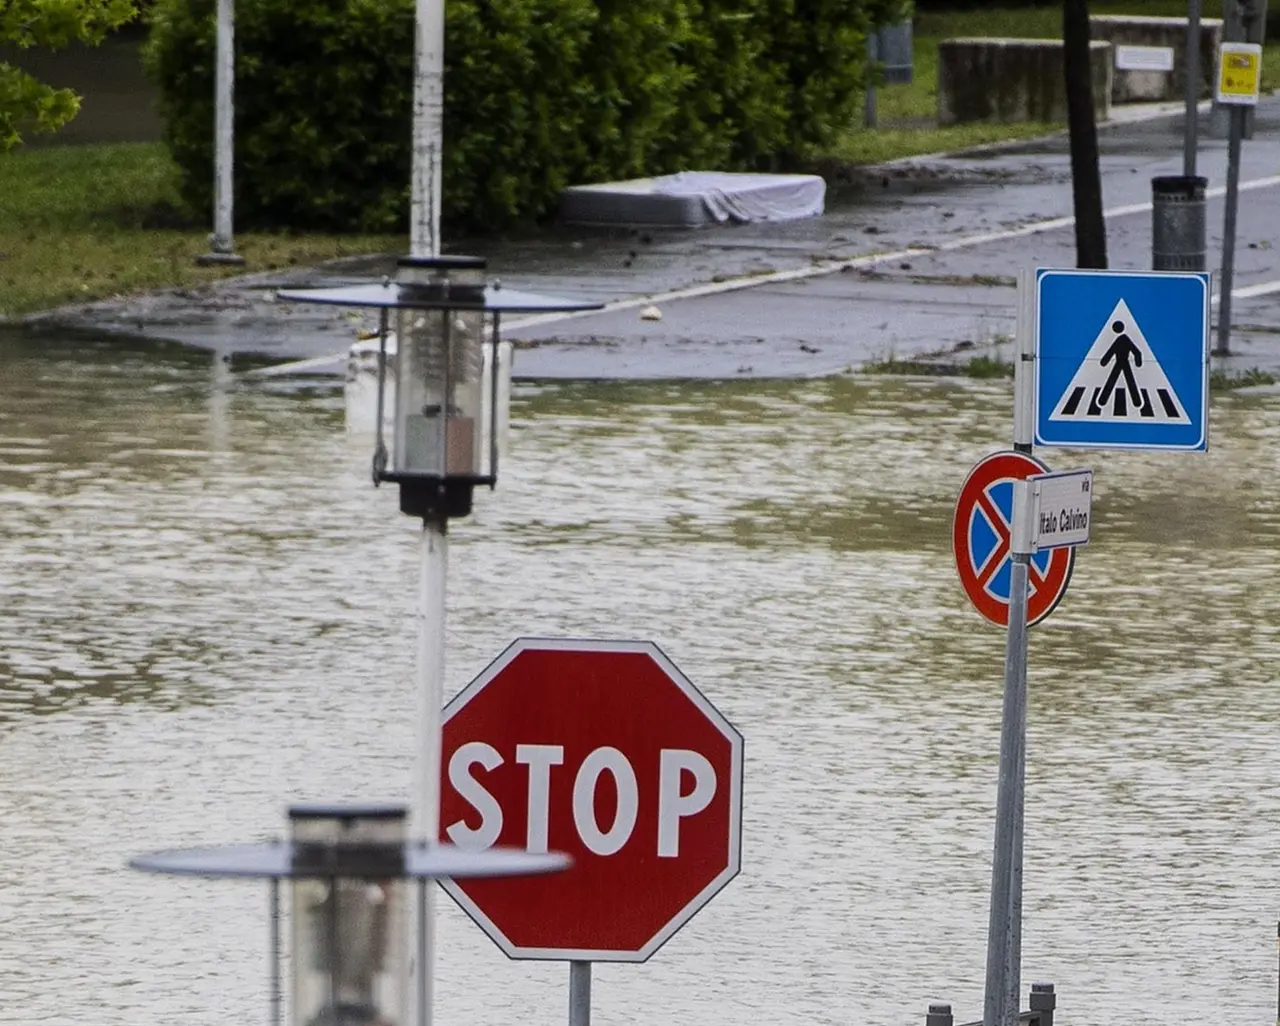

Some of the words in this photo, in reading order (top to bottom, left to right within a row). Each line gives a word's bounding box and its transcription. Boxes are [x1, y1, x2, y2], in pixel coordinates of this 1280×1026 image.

[1040, 511, 1057, 534] Italo
[1060, 508, 1087, 532] Calvino
[446, 742, 717, 858] STOP
